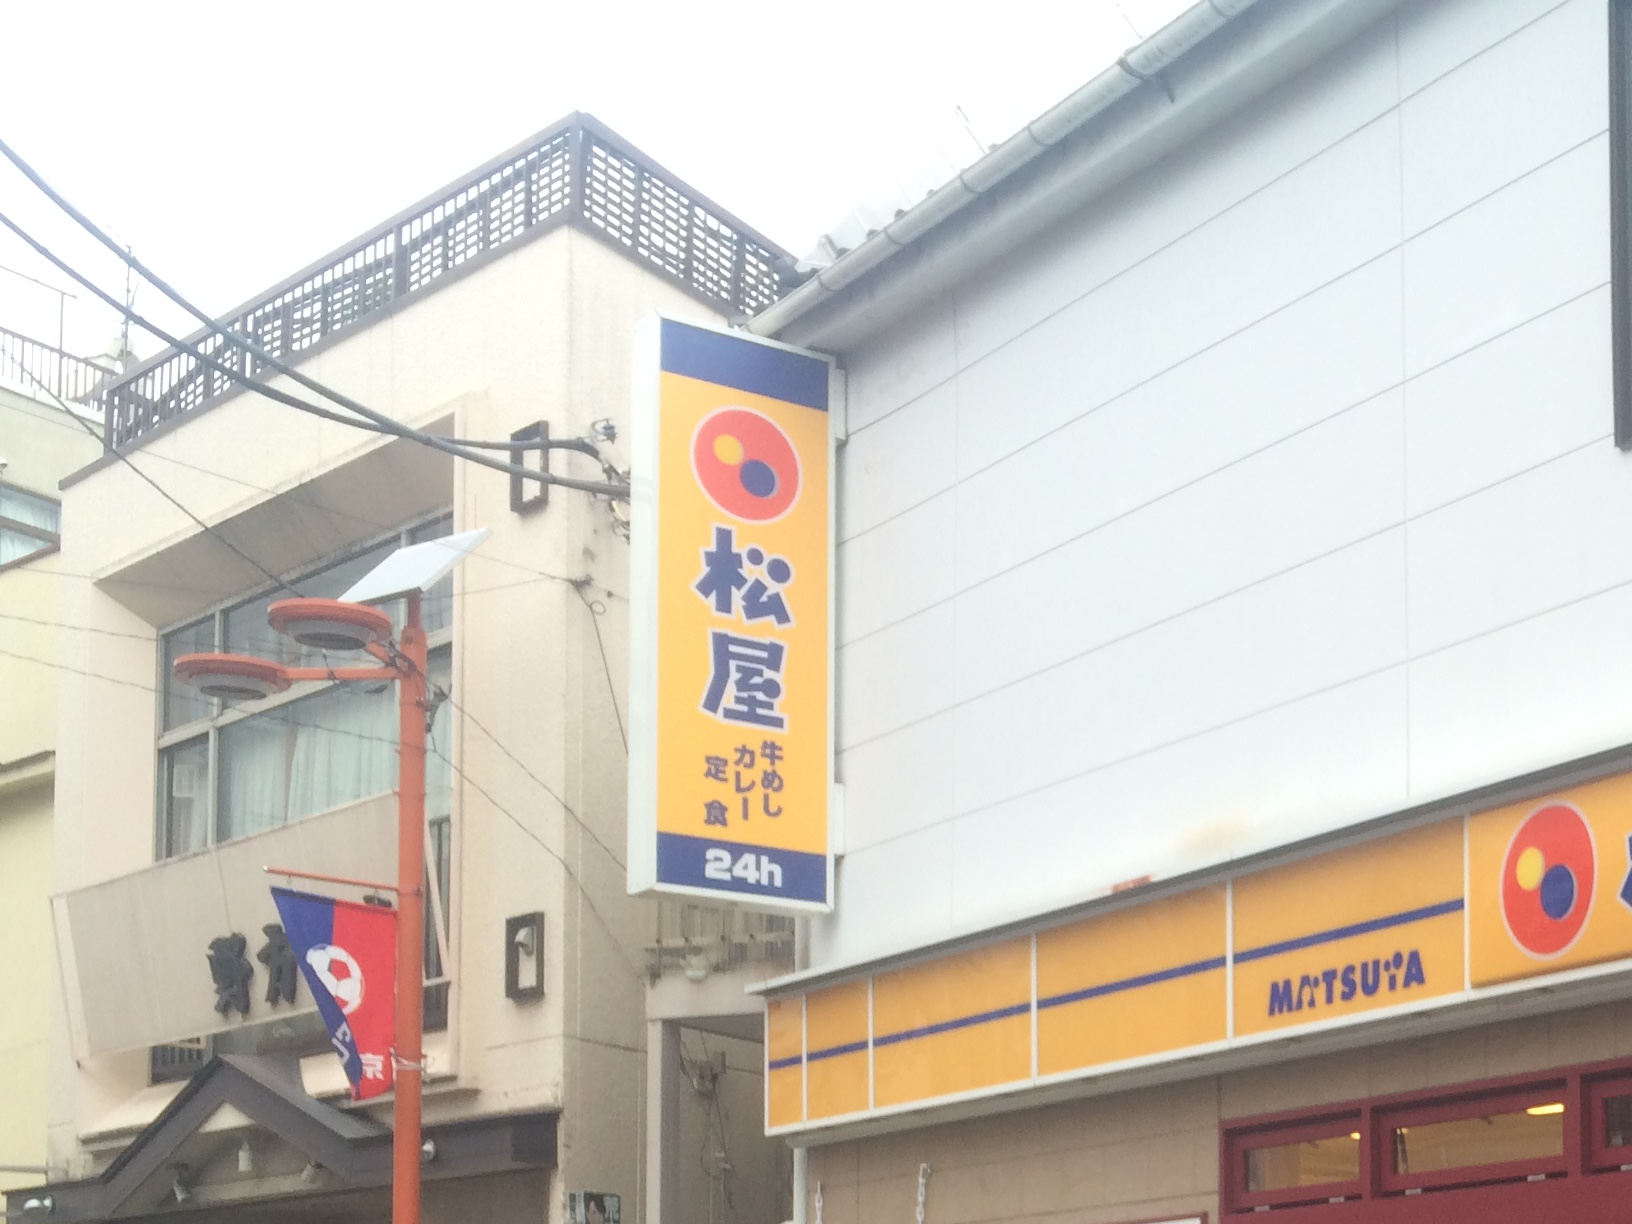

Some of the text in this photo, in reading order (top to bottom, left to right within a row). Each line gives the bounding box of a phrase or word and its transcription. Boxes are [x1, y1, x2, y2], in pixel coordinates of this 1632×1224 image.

[695, 525, 793, 731] 松屋
[704, 754, 730, 828] 定食
[732, 742, 757, 822] カレー
[761, 739, 784, 820] 牛めし
[703, 847, 783, 889] 24h
[1267, 950, 1426, 1016] MATSUYA
